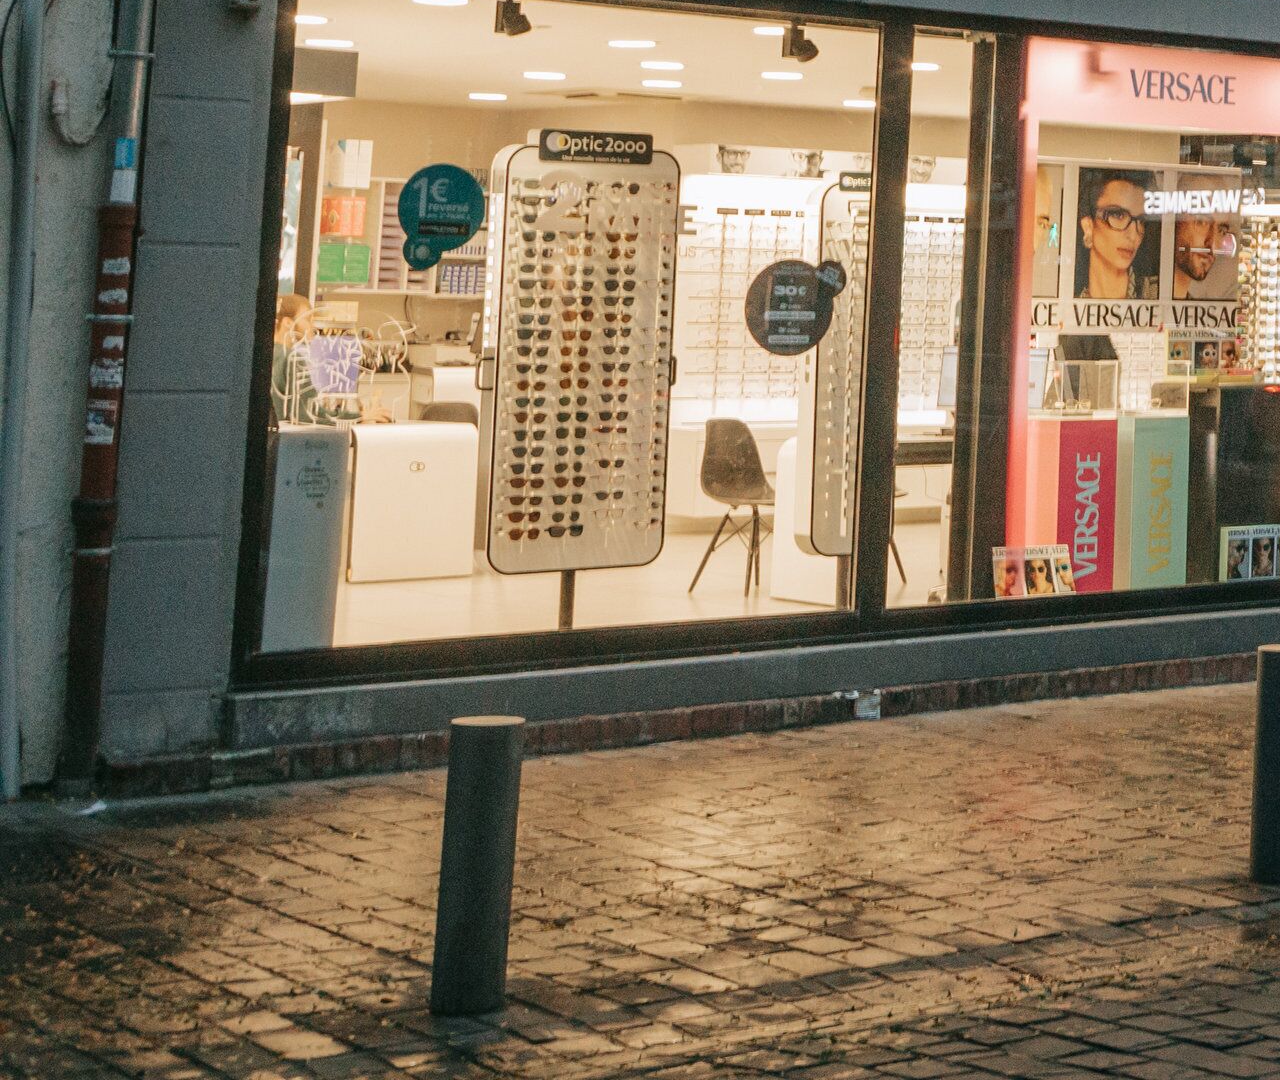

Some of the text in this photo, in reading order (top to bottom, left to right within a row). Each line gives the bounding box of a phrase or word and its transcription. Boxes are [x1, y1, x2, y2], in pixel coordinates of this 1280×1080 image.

[1130, 69, 1237, 105] VERSACE
[557, 133, 647, 155] Optic 2000
[1171, 305, 1238, 328] VERSAC
[1073, 452, 1101, 579] VERSACE
[1147, 450, 1174, 575] VERSACE
